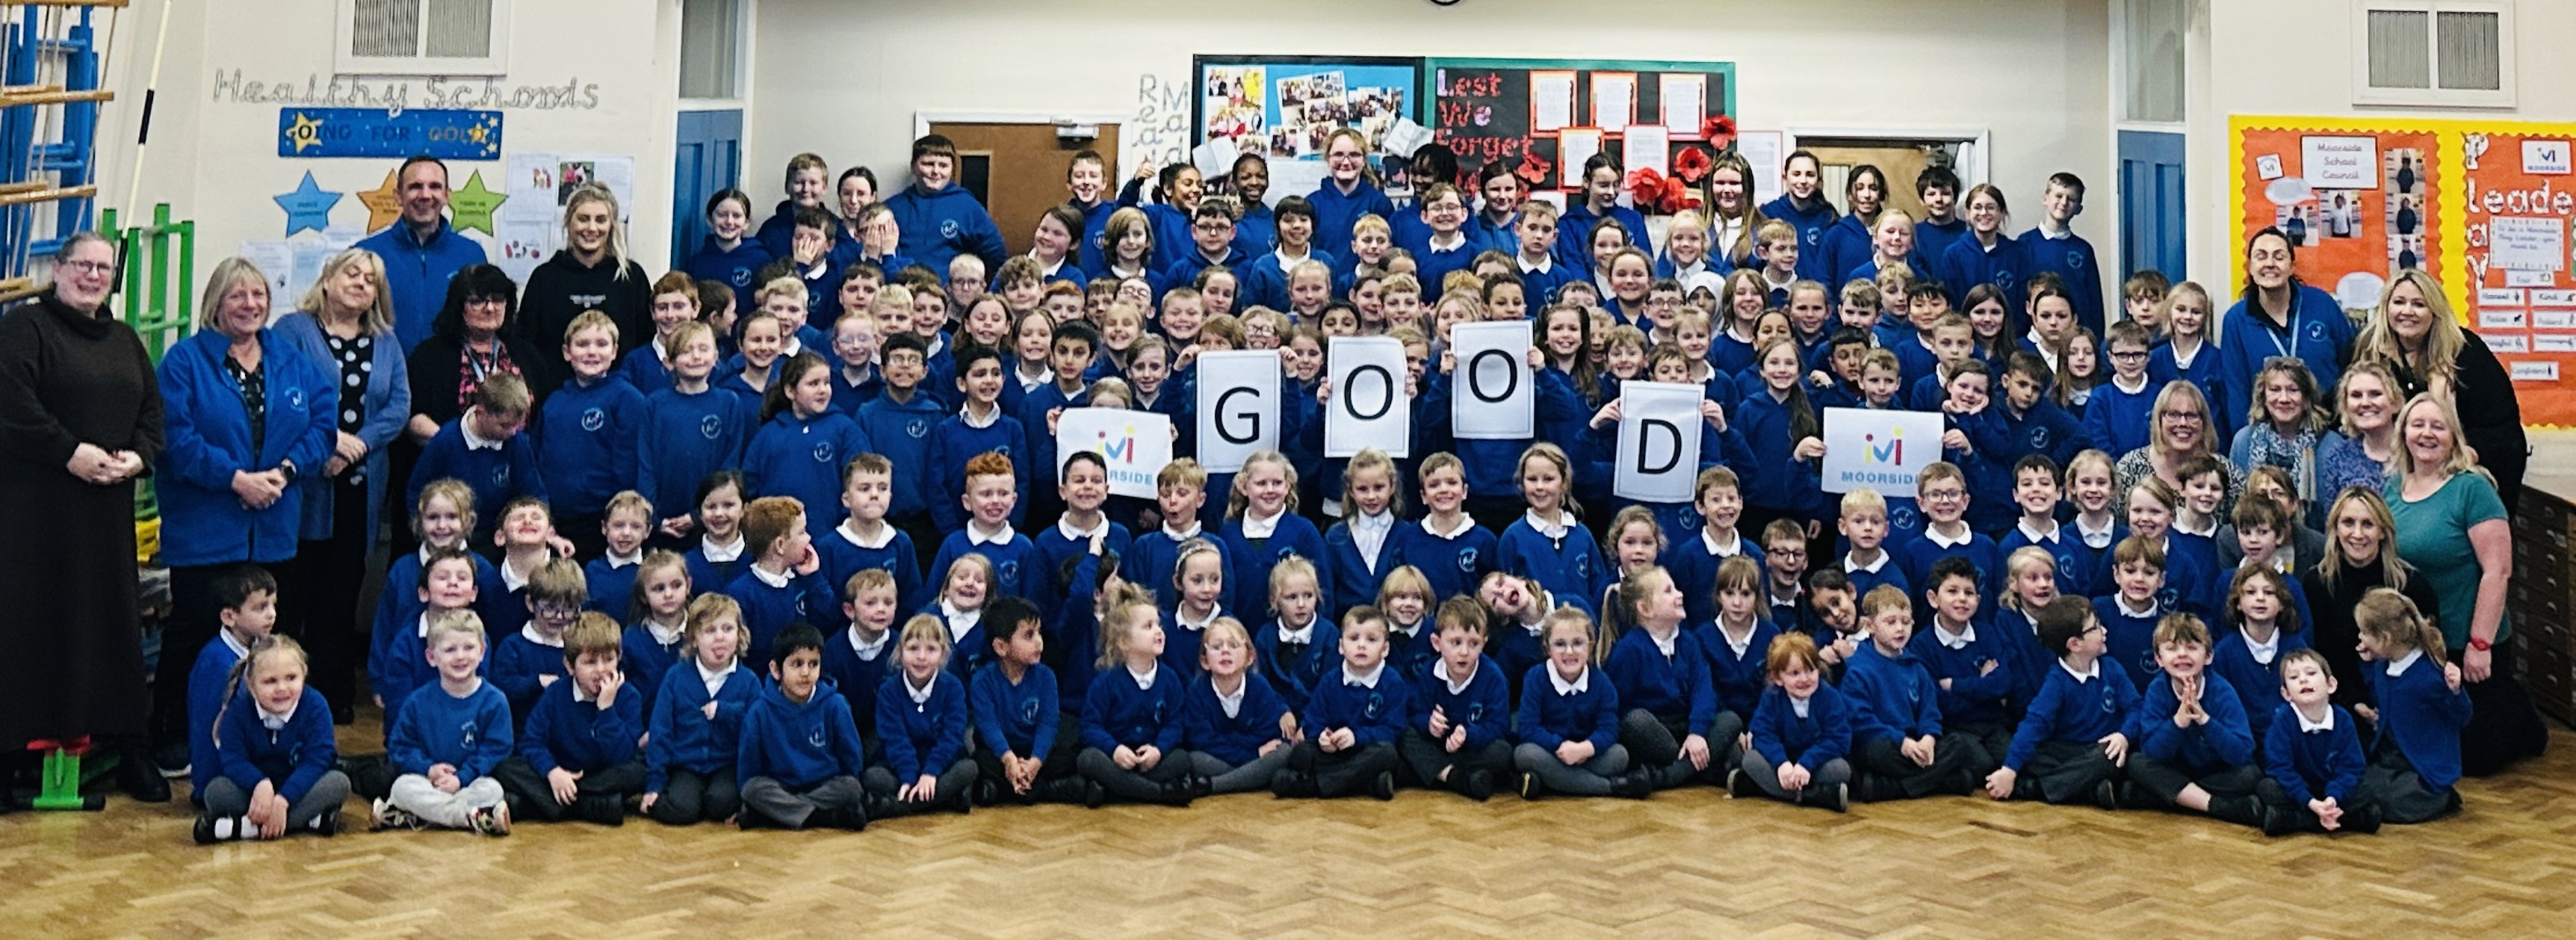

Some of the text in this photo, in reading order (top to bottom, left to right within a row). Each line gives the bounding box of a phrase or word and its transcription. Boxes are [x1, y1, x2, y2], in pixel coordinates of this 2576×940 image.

[214, 67, 599, 117] Healthy Schools
[1437, 69, 1502, 97] Lest
[1439, 100, 1492, 127] We
[1436, 128, 1534, 165] Forget
[2323, 171, 2359, 179] Council
[2324, 157, 2357, 166] School
[1109, 470, 1153, 485] RSIDE
